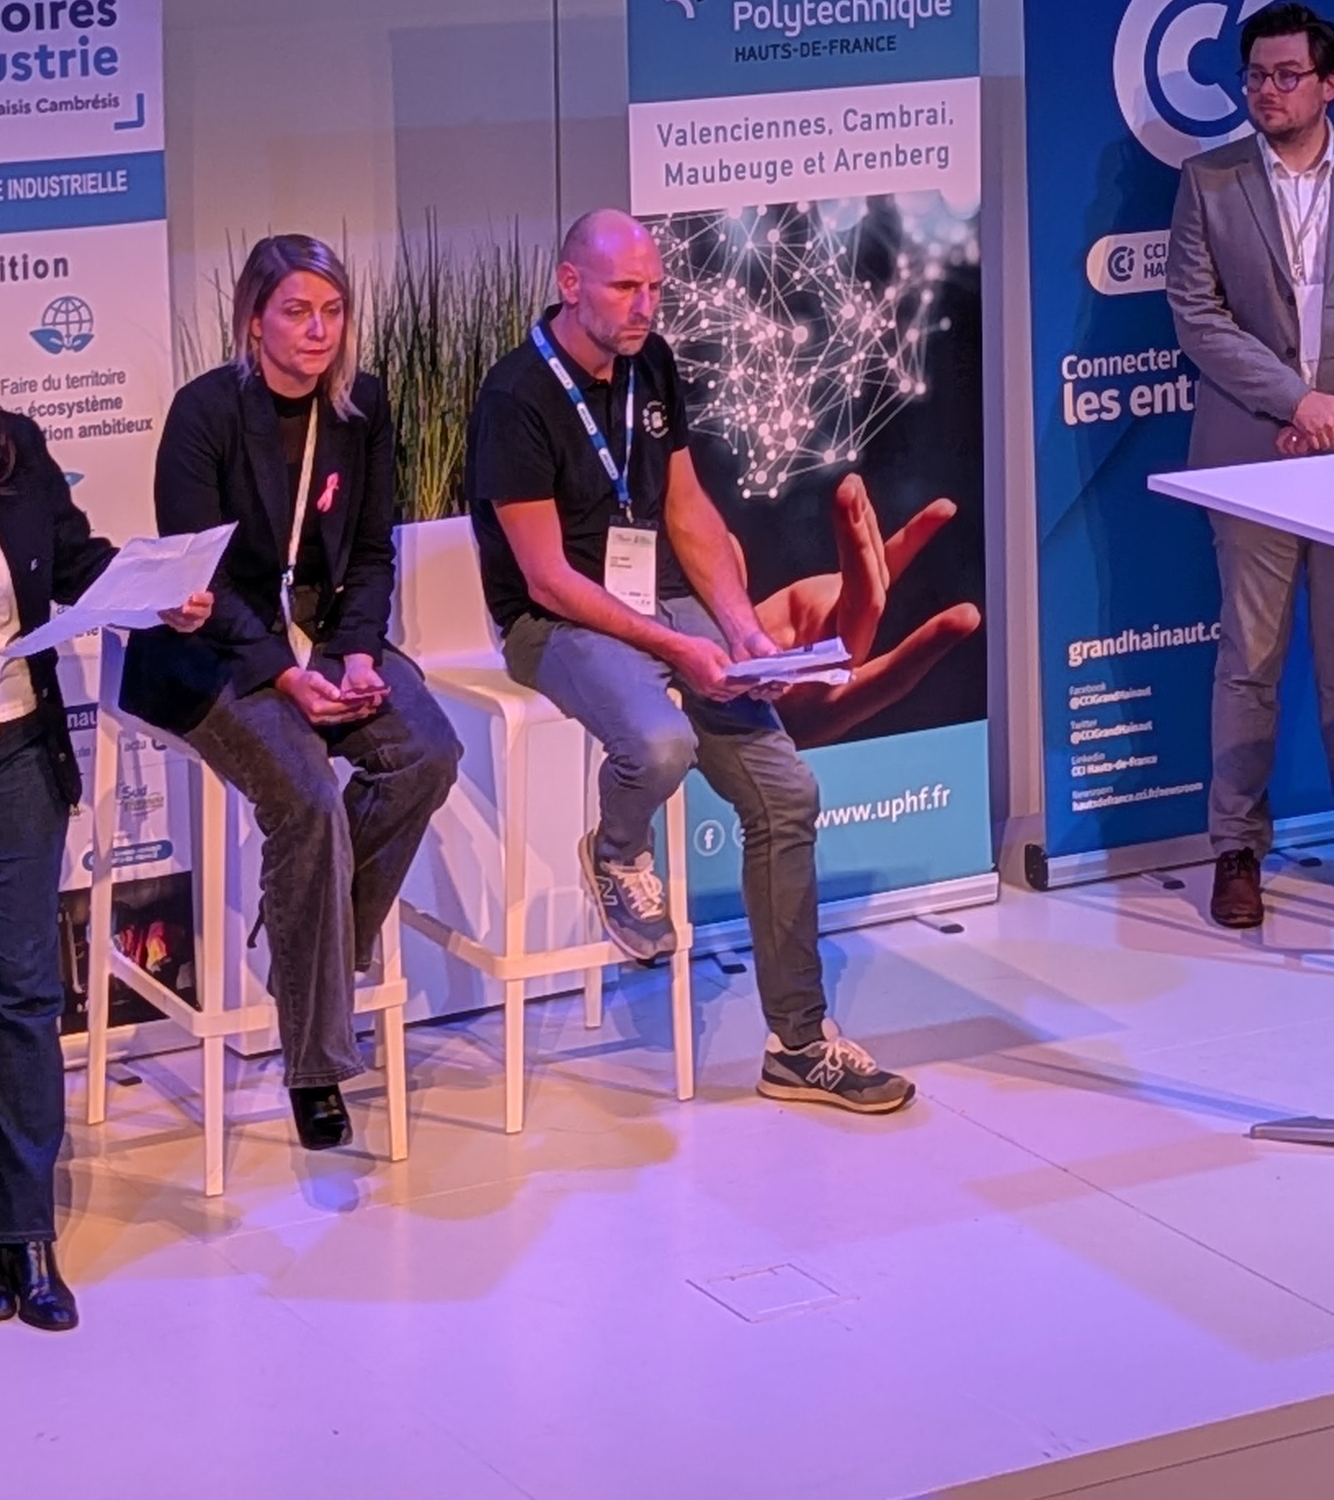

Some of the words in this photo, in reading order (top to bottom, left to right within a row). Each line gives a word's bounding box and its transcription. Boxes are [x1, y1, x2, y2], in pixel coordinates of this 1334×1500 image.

[733, 34, 898, 64] HAUTS-DE-FRANCE
[35, 93, 121, 115] Cambrésis
[656, 112, 834, 150] Valenciennes,
[841, 98, 955, 133] Cambrai,
[664, 152, 795, 190] Maubeuge
[802, 151, 827, 176] et
[834, 140, 951, 178] Arenberg
[7, 169, 129, 201] INDUSTRIELLE
[1144, 243, 1166, 260] CCI
[1061, 348, 1182, 380] Connecter
[0, 376, 37, 396] Faire
[40, 372, 63, 392] du
[65, 368, 127, 390] territoire
[28, 394, 124, 419] écosystème
[1062, 382, 1122, 426] les
[1128, 373, 1199, 418] ent
[41, 426, 74, 442] tion
[78, 417, 154, 439] ambitieux
[814, 784, 951, 829] www.uphf.fr
